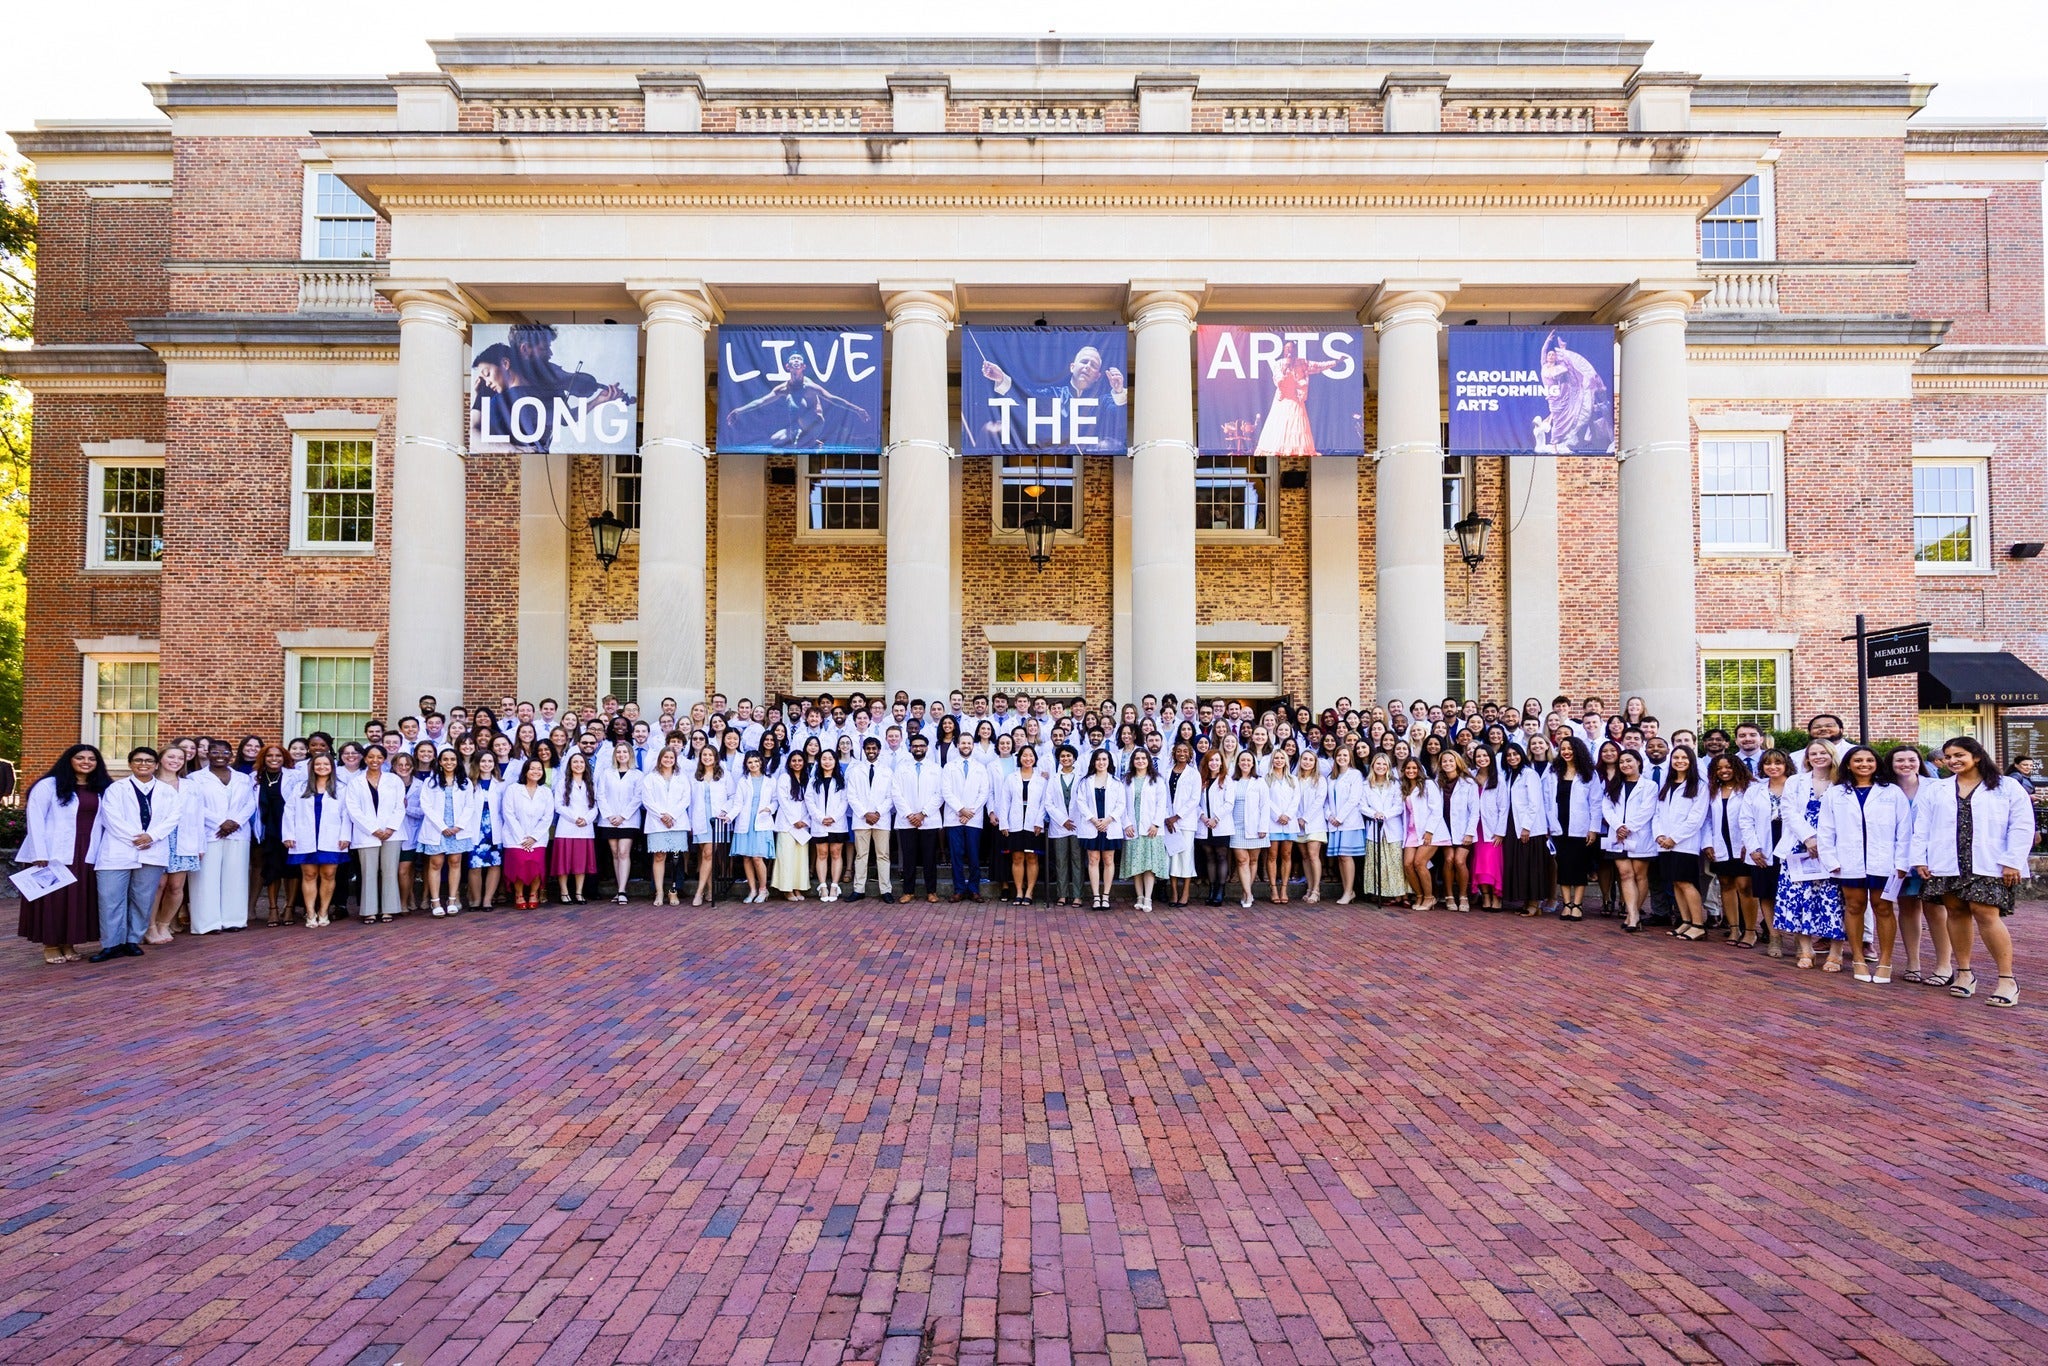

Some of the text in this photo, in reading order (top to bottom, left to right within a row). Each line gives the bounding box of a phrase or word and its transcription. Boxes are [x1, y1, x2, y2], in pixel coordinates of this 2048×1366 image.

[725, 332, 876, 383] LIVE
[1206, 332, 1355, 379] ARTS
[1456, 370, 1540, 383] CAROLINA
[1456, 385, 1560, 397] PERFORMING
[1456, 399, 1499, 411] ARTS
[481, 396, 628, 444] LONG
[988, 397, 1099, 445] THE
[1874, 645, 1921, 658] MEMORIAL
[1885, 657, 1909, 667] HALL
